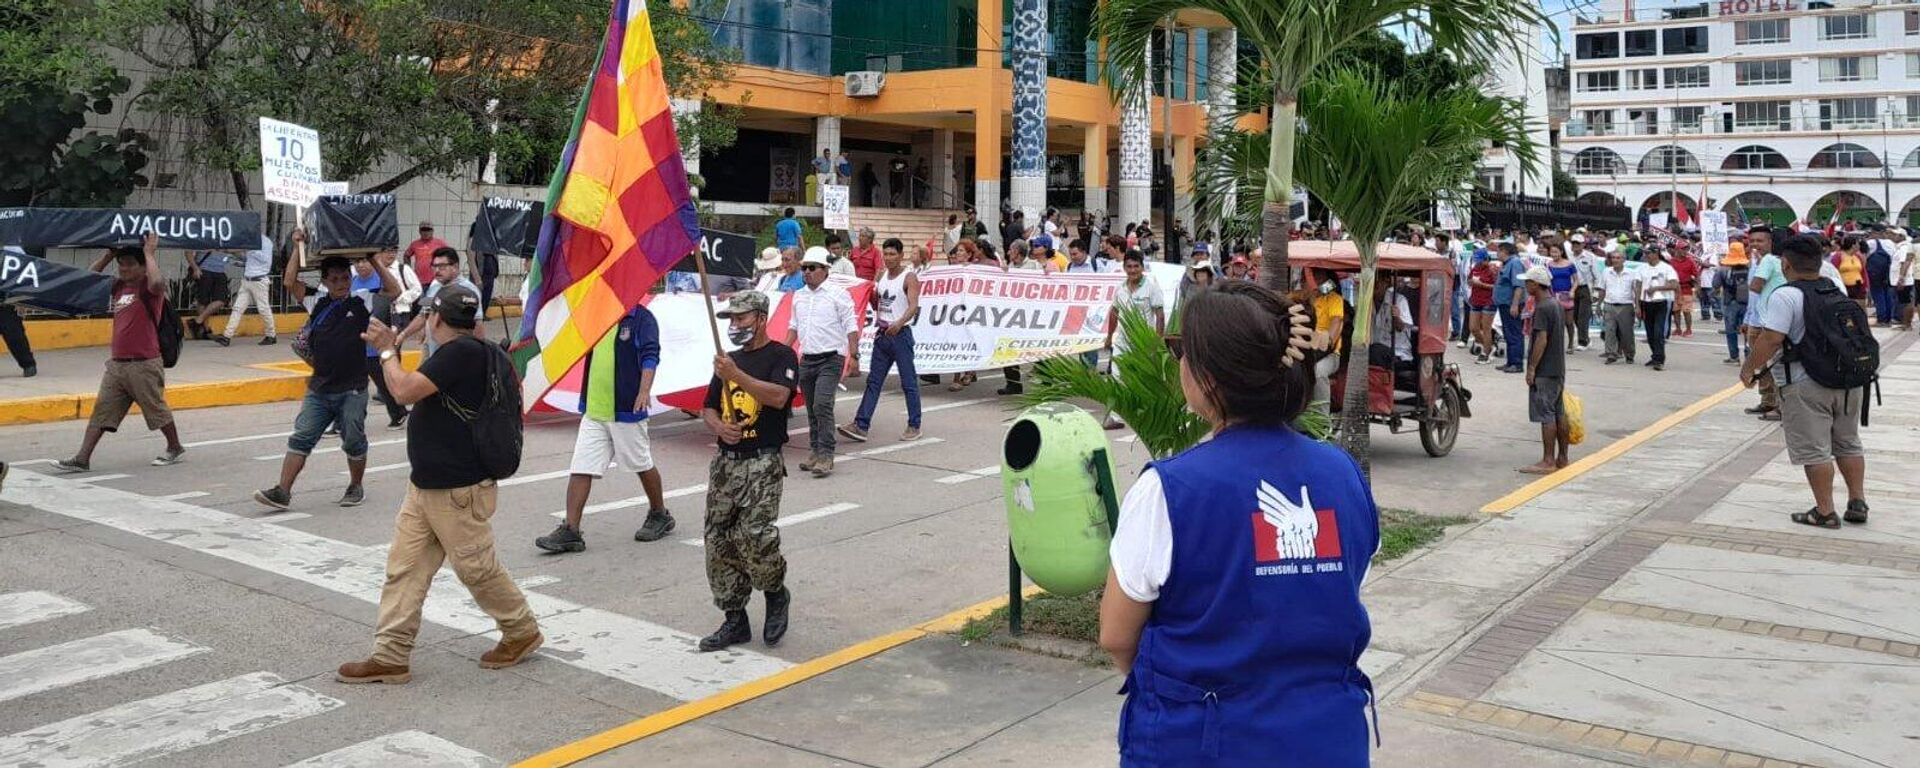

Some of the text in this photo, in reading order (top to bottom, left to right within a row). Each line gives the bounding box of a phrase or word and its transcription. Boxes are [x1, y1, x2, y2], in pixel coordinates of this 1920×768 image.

[1719, 0, 1797, 15] HOTEL
[276, 136, 304, 161] 10
[265, 157, 318, 175] MUERTOS
[110, 213, 232, 241] AYACUCHO
[1, 255, 39, 288] PA
[968, 279, 995, 296] DE
[999, 281, 1068, 300] LUCHA
[1074, 285, 1101, 301] DE
[929, 304, 1060, 329] UCAYALI
[1302, 564, 1314, 573] DEL
[1317, 561, 1343, 573] PUEBLO
